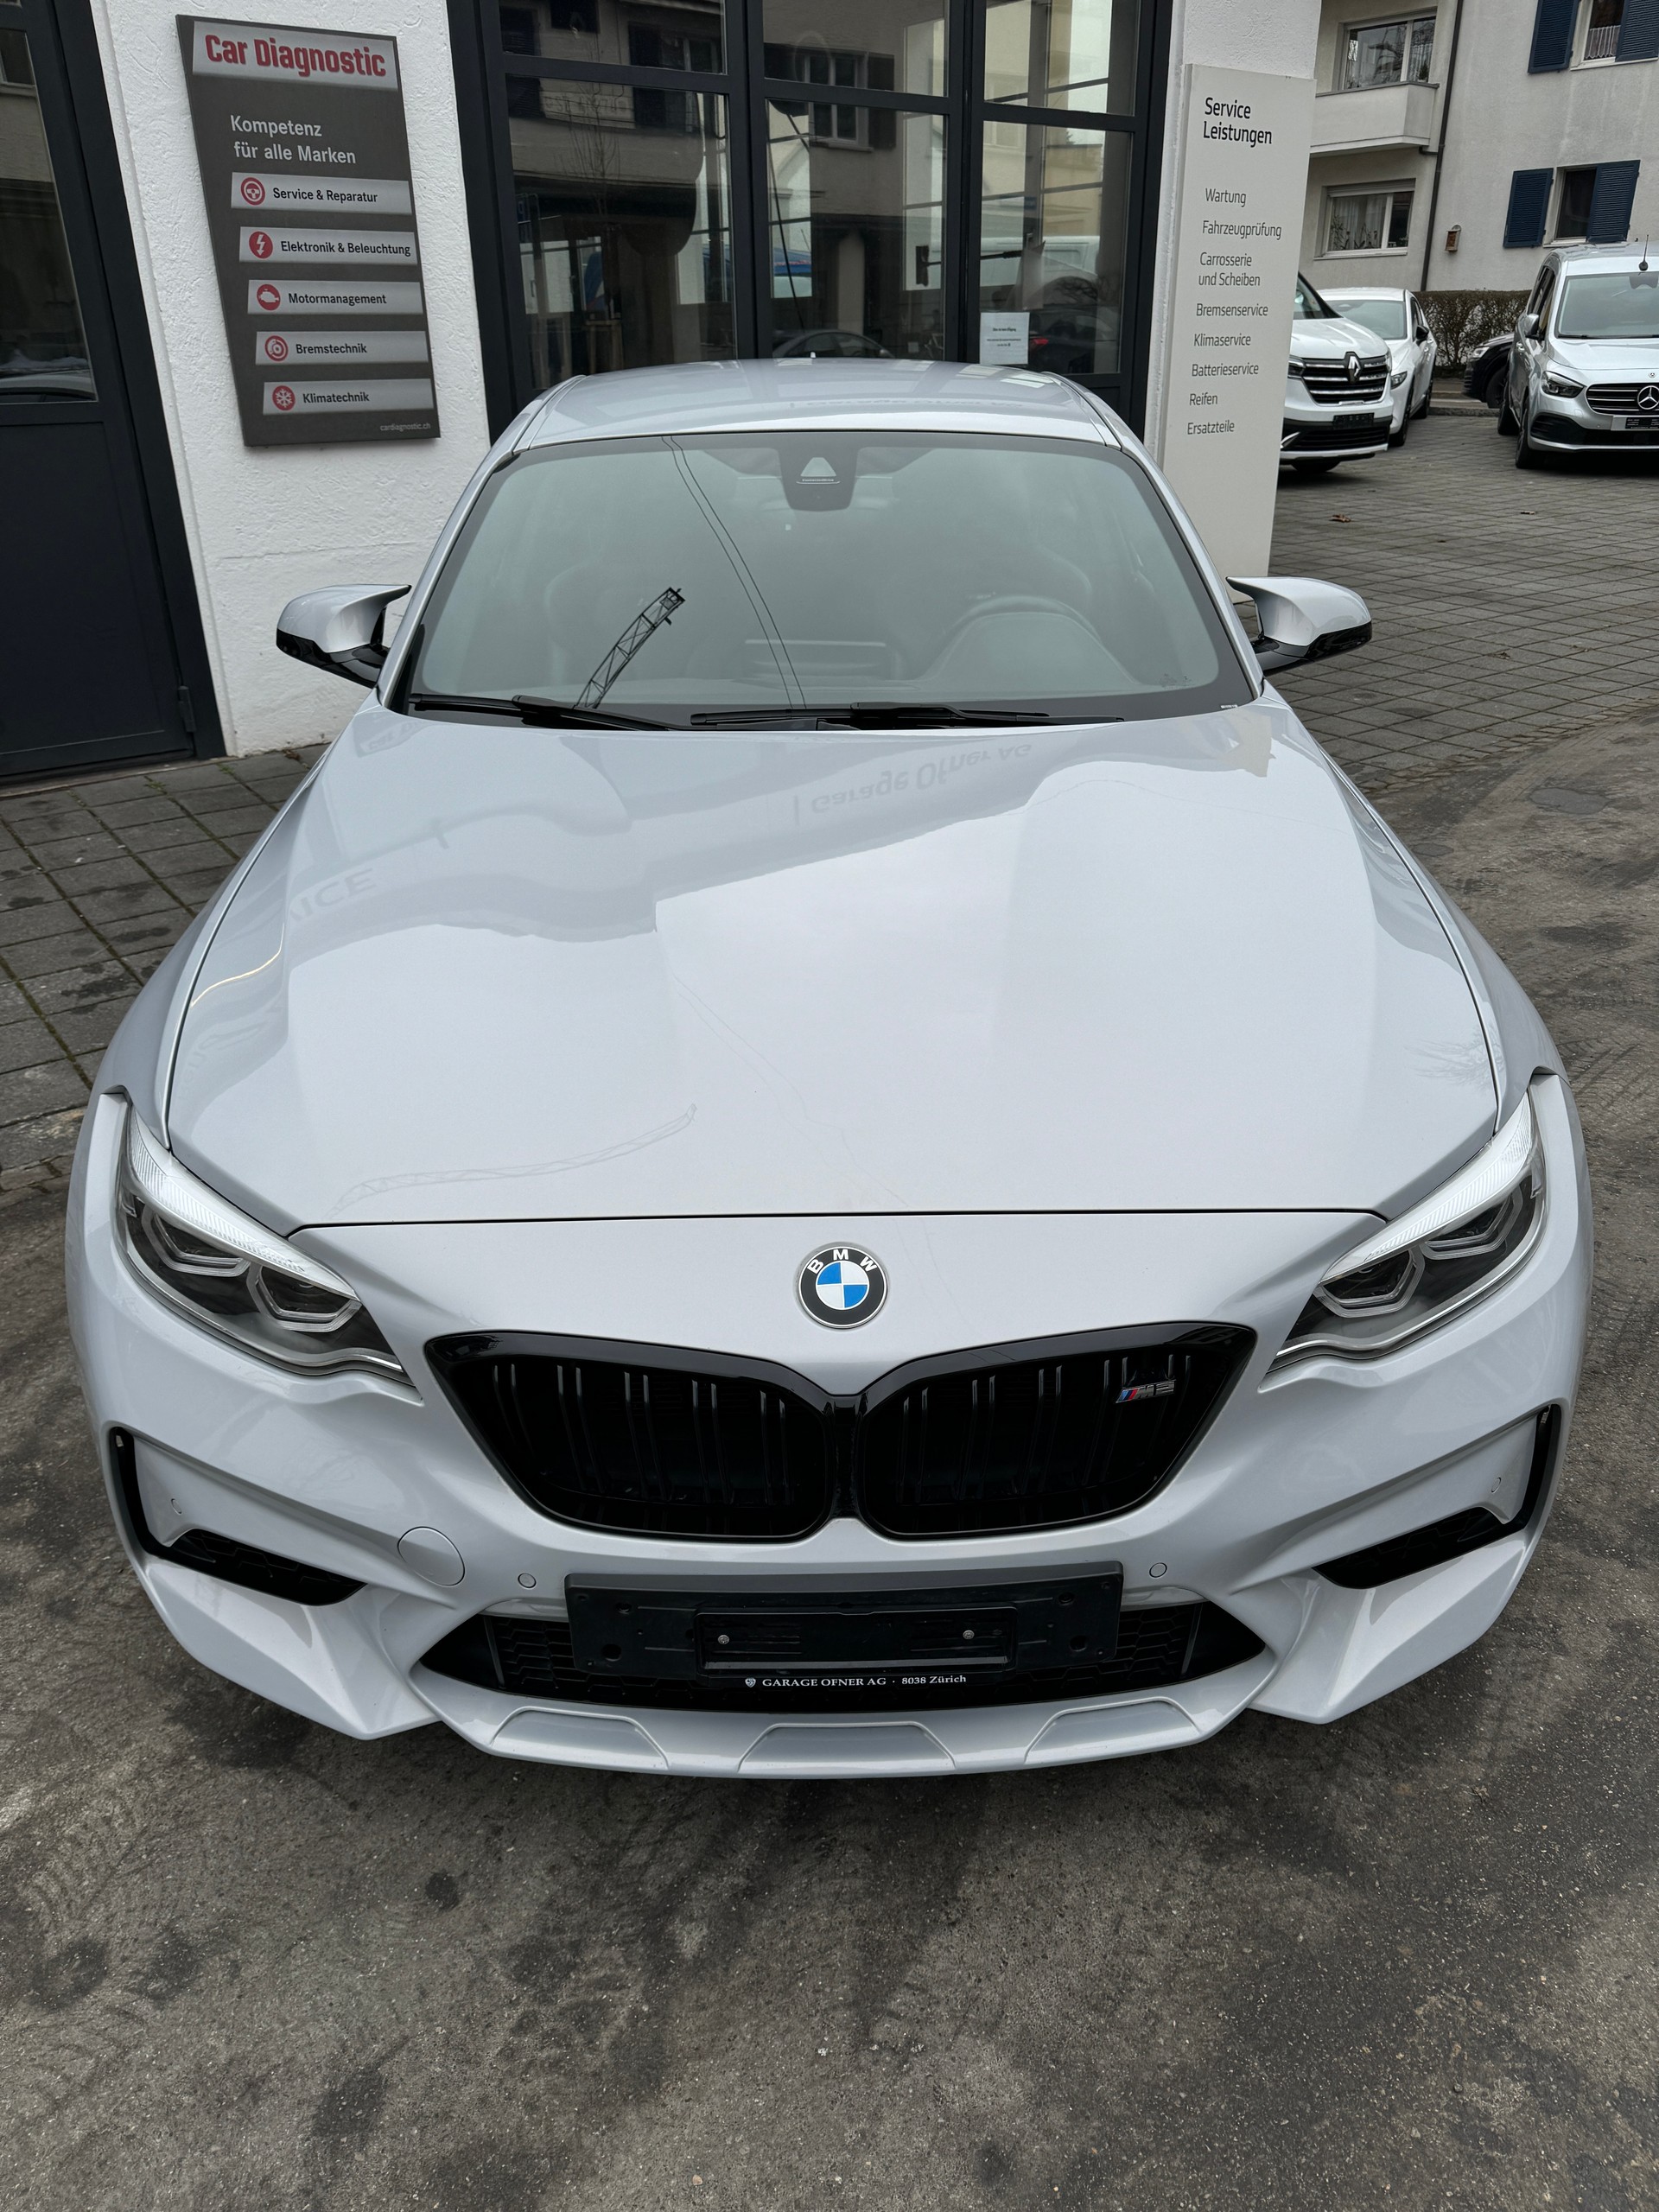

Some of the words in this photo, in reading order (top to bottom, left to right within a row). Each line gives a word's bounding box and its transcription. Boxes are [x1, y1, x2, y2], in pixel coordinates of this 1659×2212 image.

[205, 35, 247, 64] Car
[253, 37, 386, 77] Diagnostic
[1205, 97, 1251, 119] Service
[230, 115, 322, 137] Kompetenz
[1203, 121, 1273, 148] Leistungen
[233, 141, 258, 159] für
[264, 143, 293, 161] alle
[298, 145, 356, 163] Marken
[272, 187, 314, 200] Service
[316, 189, 324, 200] &
[327, 189, 378, 203] Reparatur
[1205, 188, 1247, 207] Wartung
[1202, 219, 1282, 240] Fahrzeugprüfung
[280, 240, 335, 253] Elektronik
[338, 243, 345, 253] &
[347, 243, 411, 257] Beleuchtung
[1199, 251, 1252, 267] Carrosserie
[1198, 272, 1217, 286] und
[1219, 272, 1261, 286] Scheiben
[288, 292, 387, 306] Motormanagement
[1196, 302, 1268, 316] Bremsenservice
[1193, 333, 1251, 346] Klimaservice
[296, 343, 367, 354] Bremstechnik
[1192, 362, 1259, 377] Batterieservice
[302, 392, 370, 404] Klimatechnik
[1189, 392, 1218, 406] Reifen
[379, 423, 431, 432] cardiagnostic.ch
[1187, 419, 1235, 435] Ersatzteile
[807, 1249, 877, 1274] BMW
[762, 1677, 818, 1687] GARAGE
[820, 1677, 864, 1687] OFNER
[867, 1676, 887, 1686] AG
[901, 1675, 926, 1685] 8038
[929, 1675, 967, 1684] Zürich
